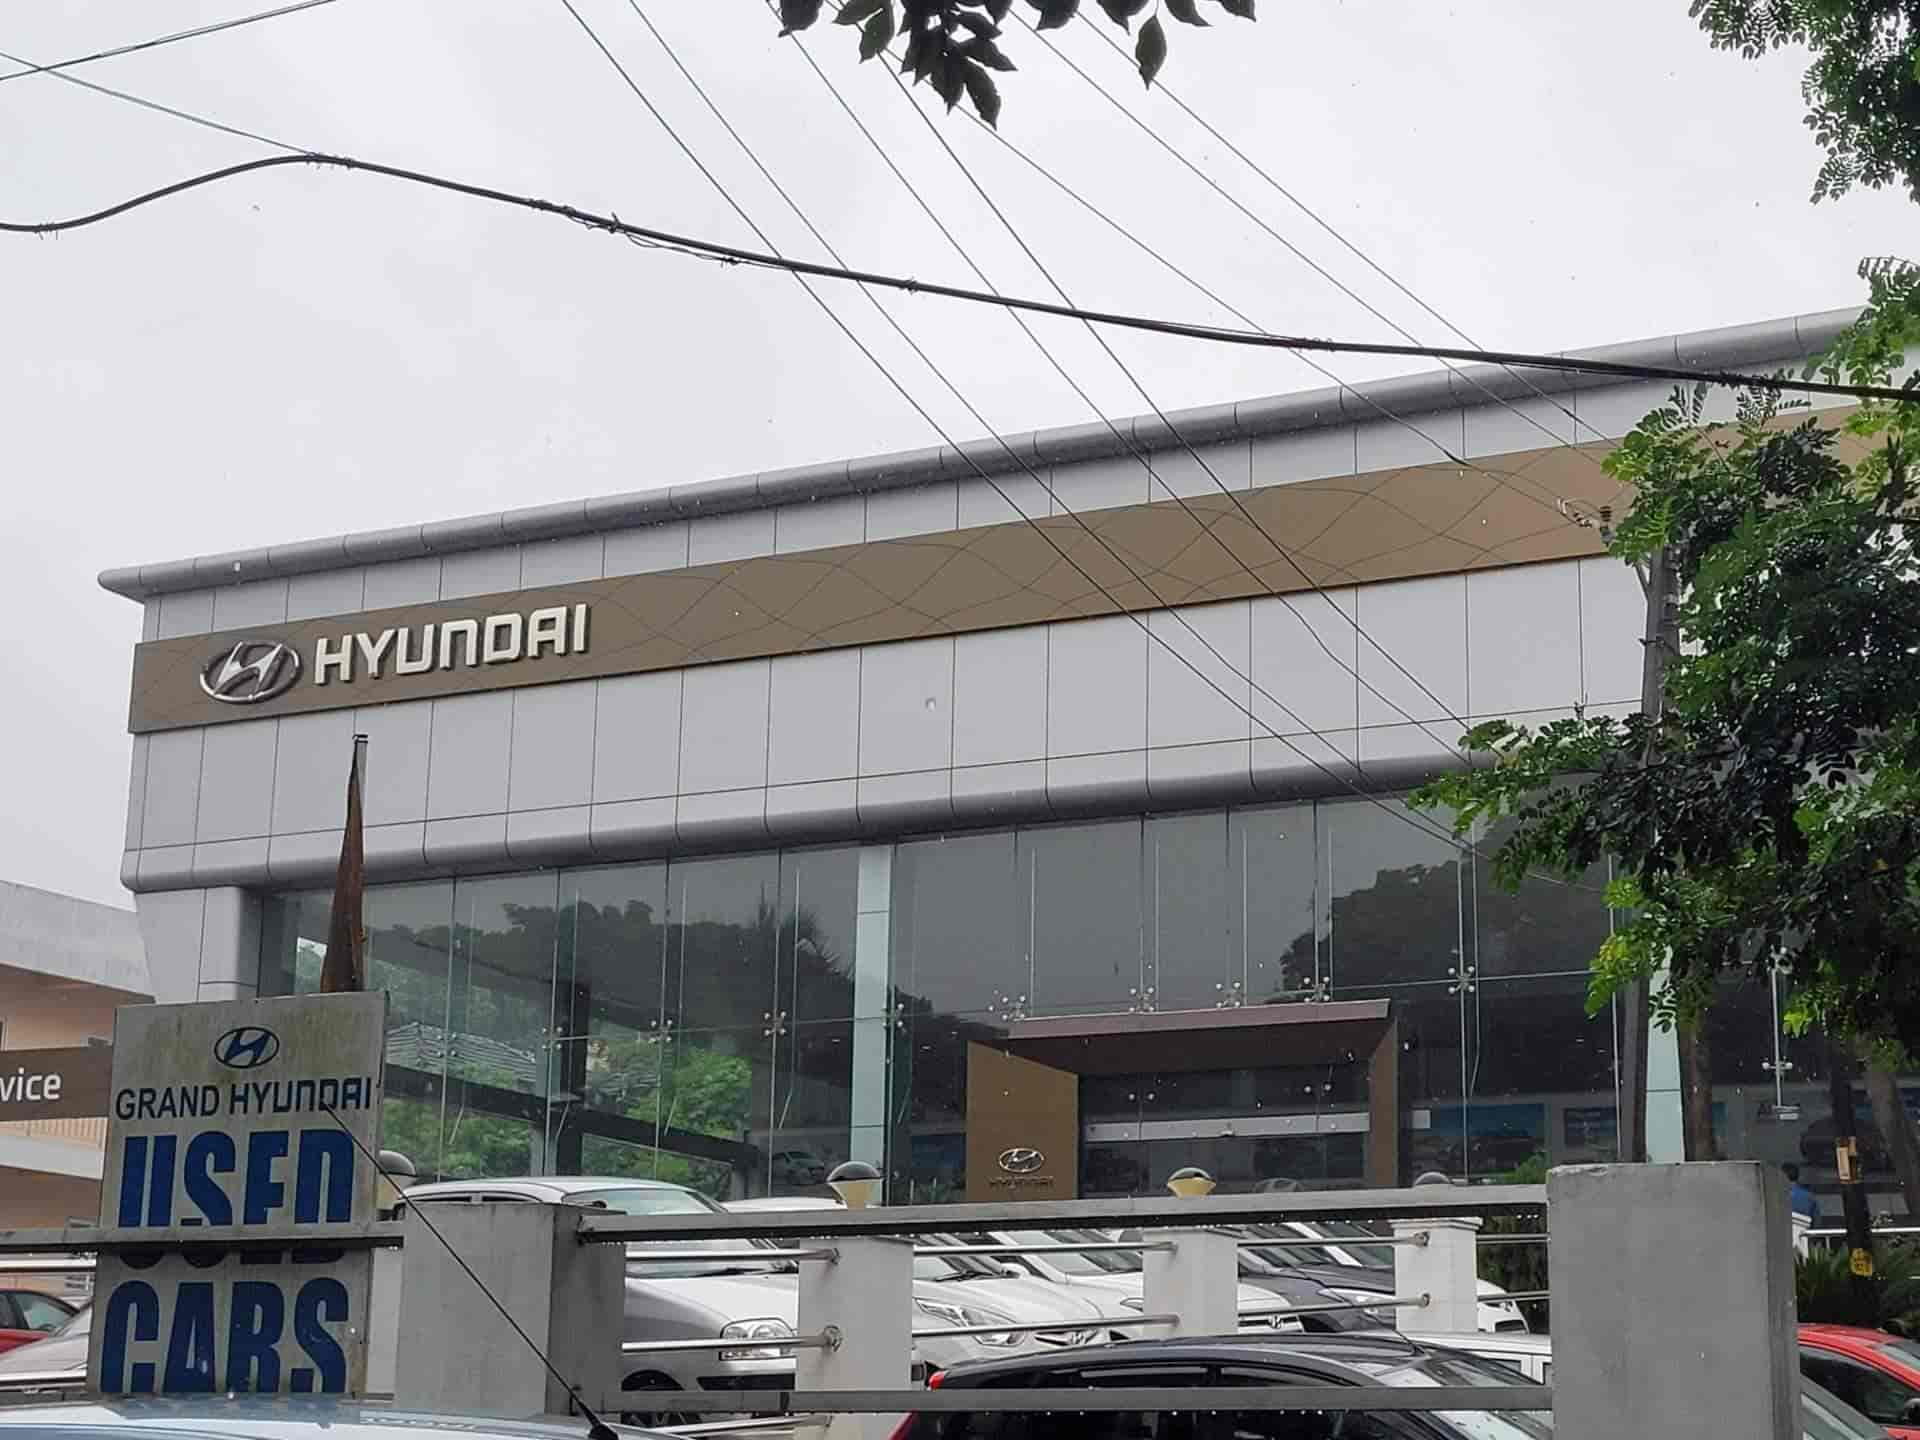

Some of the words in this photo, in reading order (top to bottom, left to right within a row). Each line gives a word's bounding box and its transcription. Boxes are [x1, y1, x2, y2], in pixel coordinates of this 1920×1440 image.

[314, 603, 588, 685] HYUNDAI
[115, 1085, 220, 1120] GRAND
[229, 1077, 371, 1115] HYUNDAI
[100, 1277, 349, 1393] CARS
